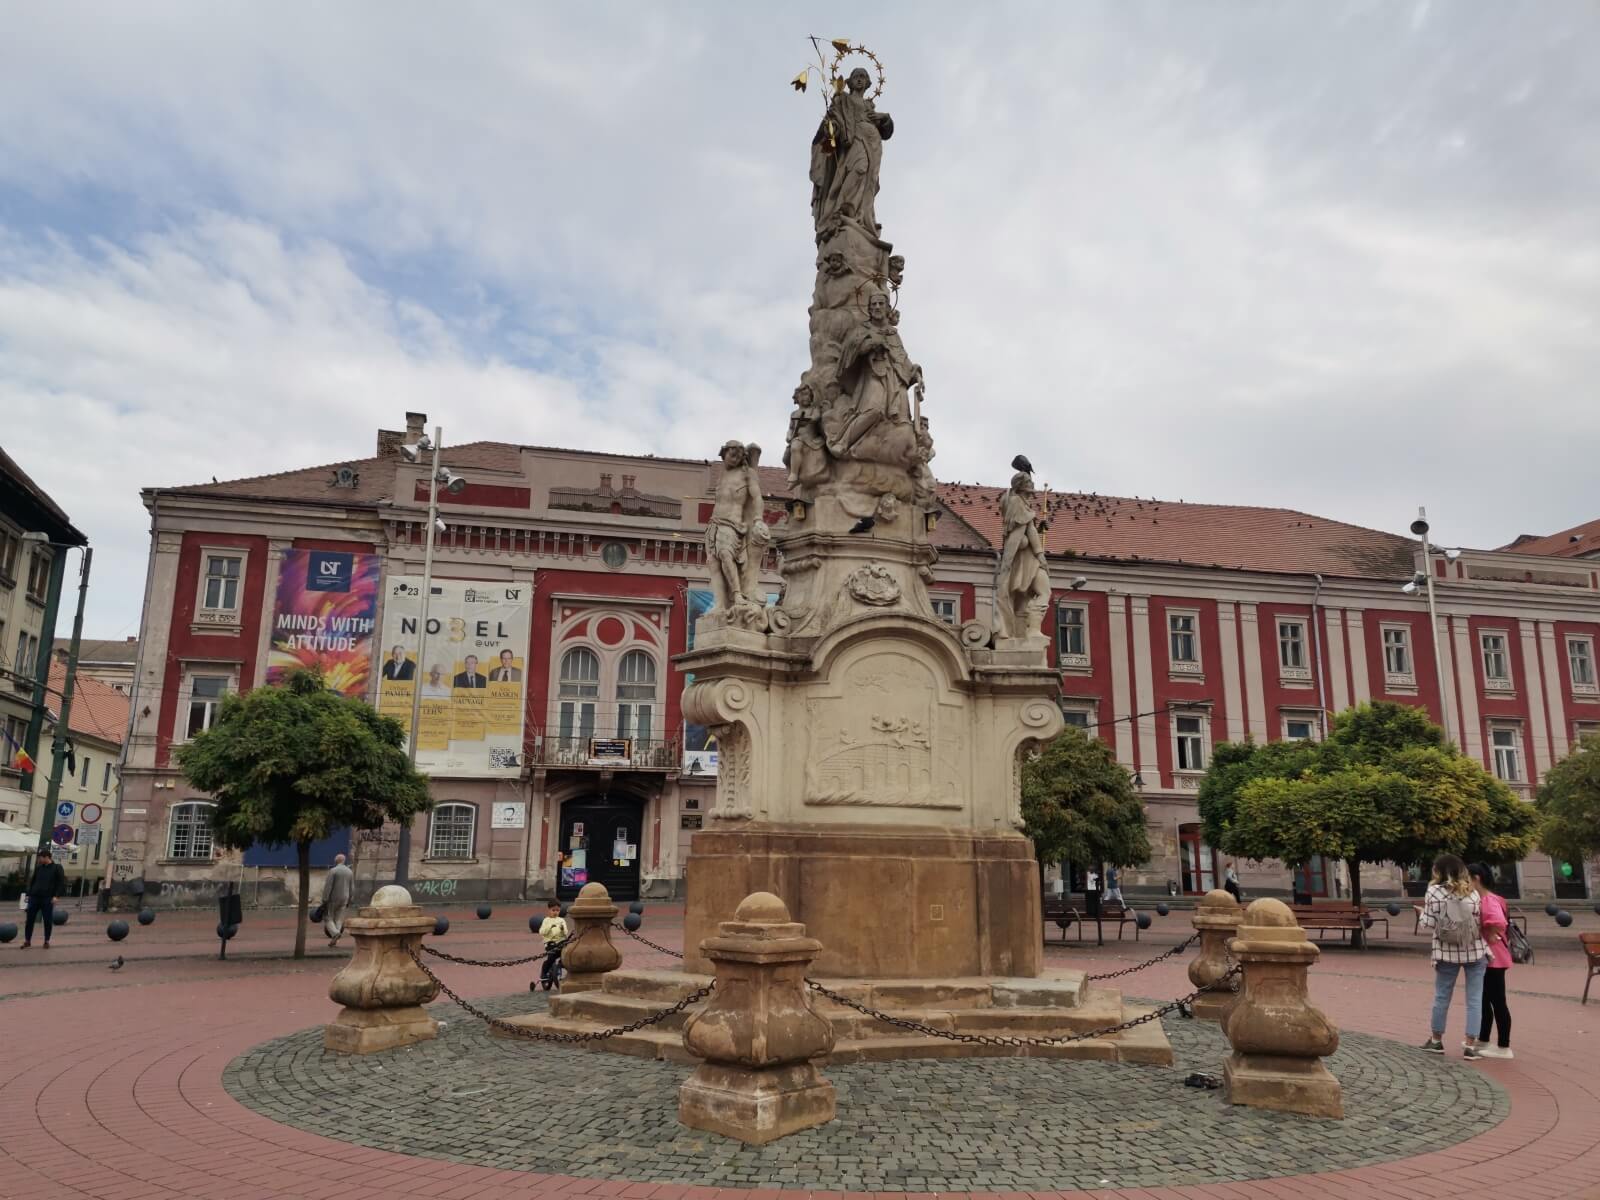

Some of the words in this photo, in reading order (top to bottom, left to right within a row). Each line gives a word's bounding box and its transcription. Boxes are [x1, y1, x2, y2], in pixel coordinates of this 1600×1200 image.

[277, 613, 326, 631] MINDS
[331, 616, 370, 633] WITH
[286, 634, 357, 653] ATTITUDE
